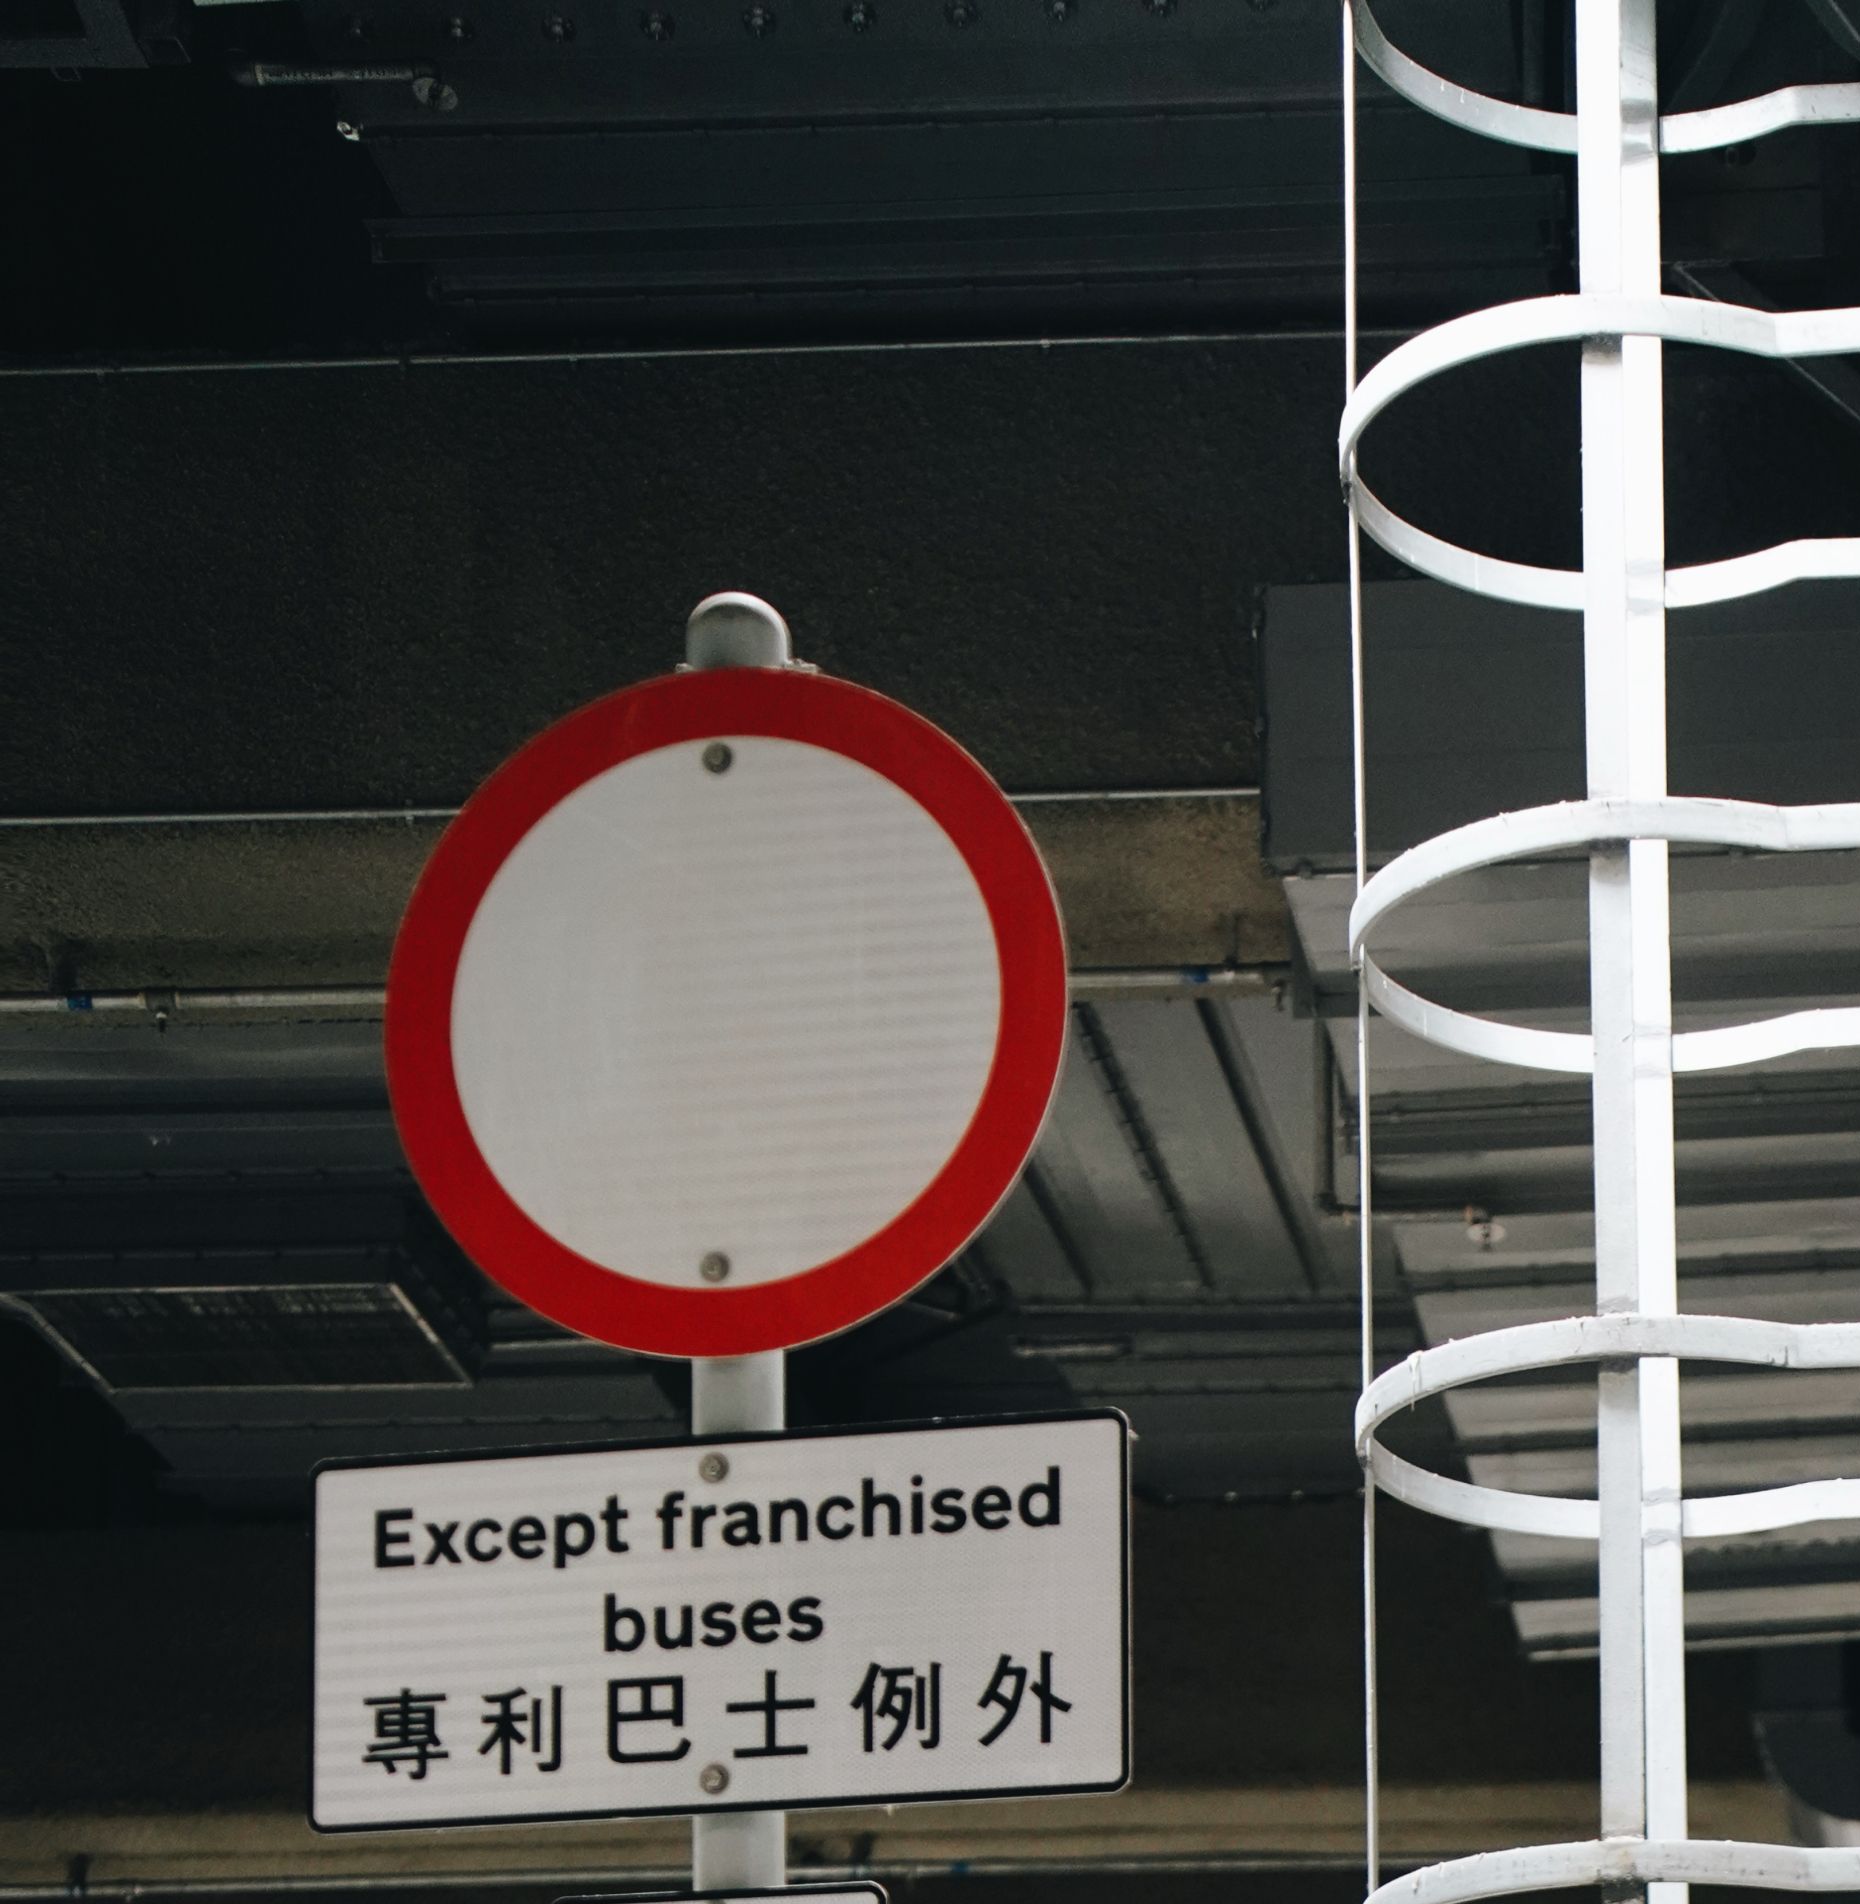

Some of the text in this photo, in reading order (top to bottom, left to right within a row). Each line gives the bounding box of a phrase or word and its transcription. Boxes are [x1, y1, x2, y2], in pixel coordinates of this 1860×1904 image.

[374, 1465, 1061, 1569] Except franchised
[604, 1592, 824, 1653] buses
[362, 1651, 1073, 1781] 專利巴士例外
